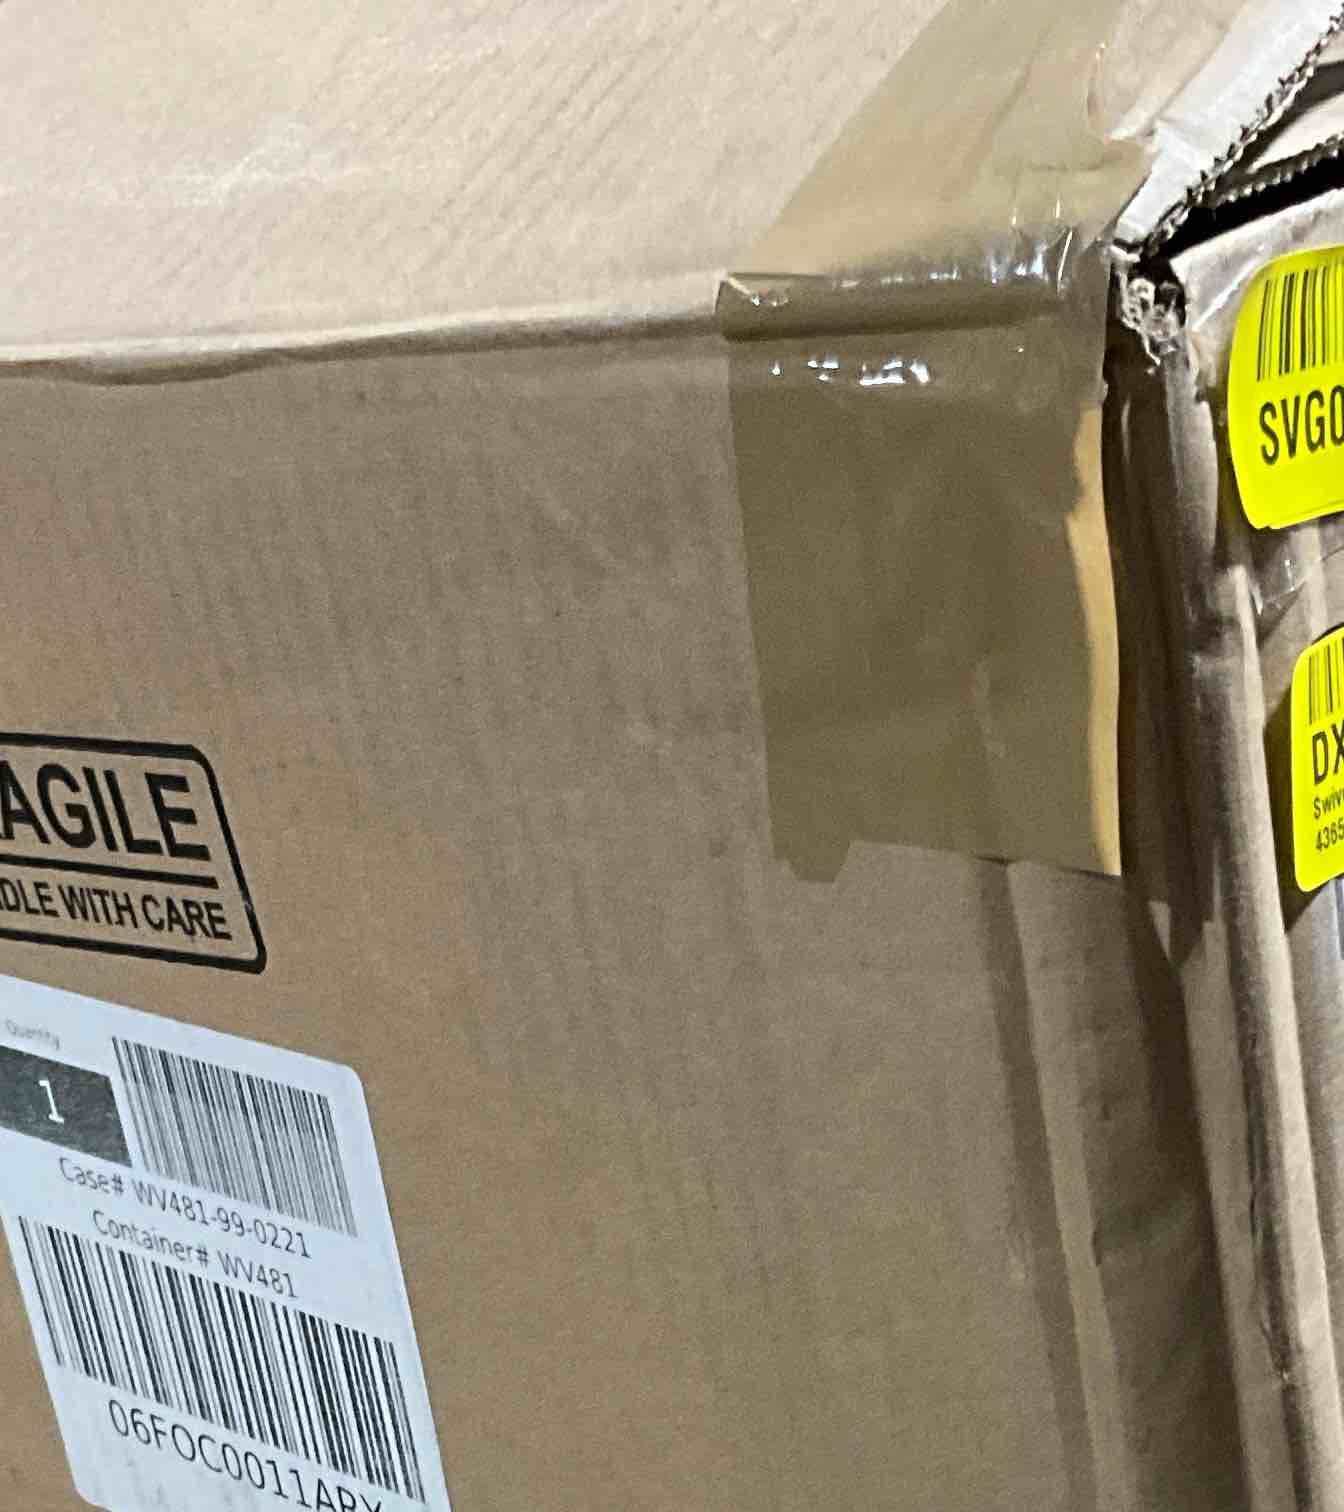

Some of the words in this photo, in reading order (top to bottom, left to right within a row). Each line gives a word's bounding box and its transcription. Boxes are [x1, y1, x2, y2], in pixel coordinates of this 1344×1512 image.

[58, 884, 139, 929] WITH
[143, 893, 233, 941] CARE
[38, 1079, 65, 1124] 1
[58, 1157, 125, 1194] Case#
[132, 1179, 312, 1259] WV481-99-0221
[92, 1209, 208, 1264] Container#
[218, 1252, 299, 1298] WV481
